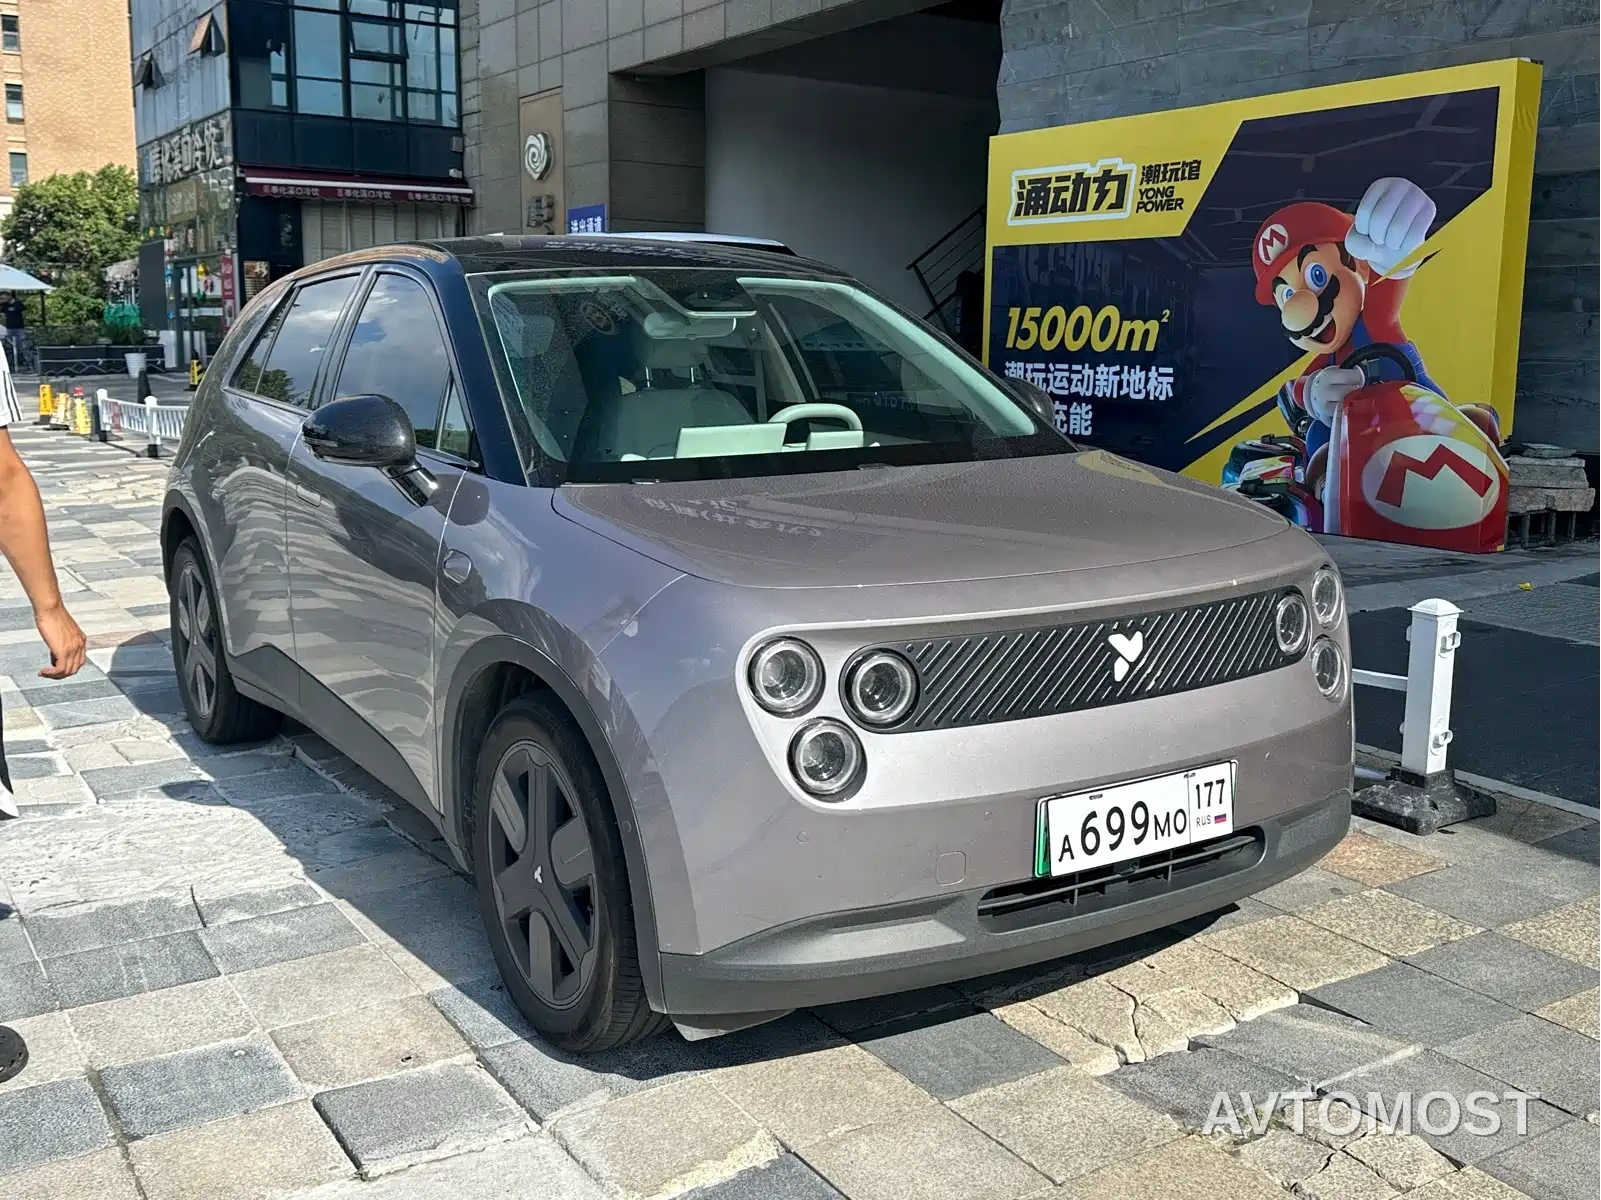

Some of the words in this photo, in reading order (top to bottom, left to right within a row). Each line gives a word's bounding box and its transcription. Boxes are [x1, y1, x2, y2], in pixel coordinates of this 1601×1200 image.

[1139, 160, 1201, 186] 潮玩馆
[1014, 168, 1128, 217] 涌动力
[1138, 186, 1175, 200] YONG
[1136, 198, 1184, 214] POWER
[1195, 779, 1226, 809] 177
[1196, 814, 1212, 827] RUS
